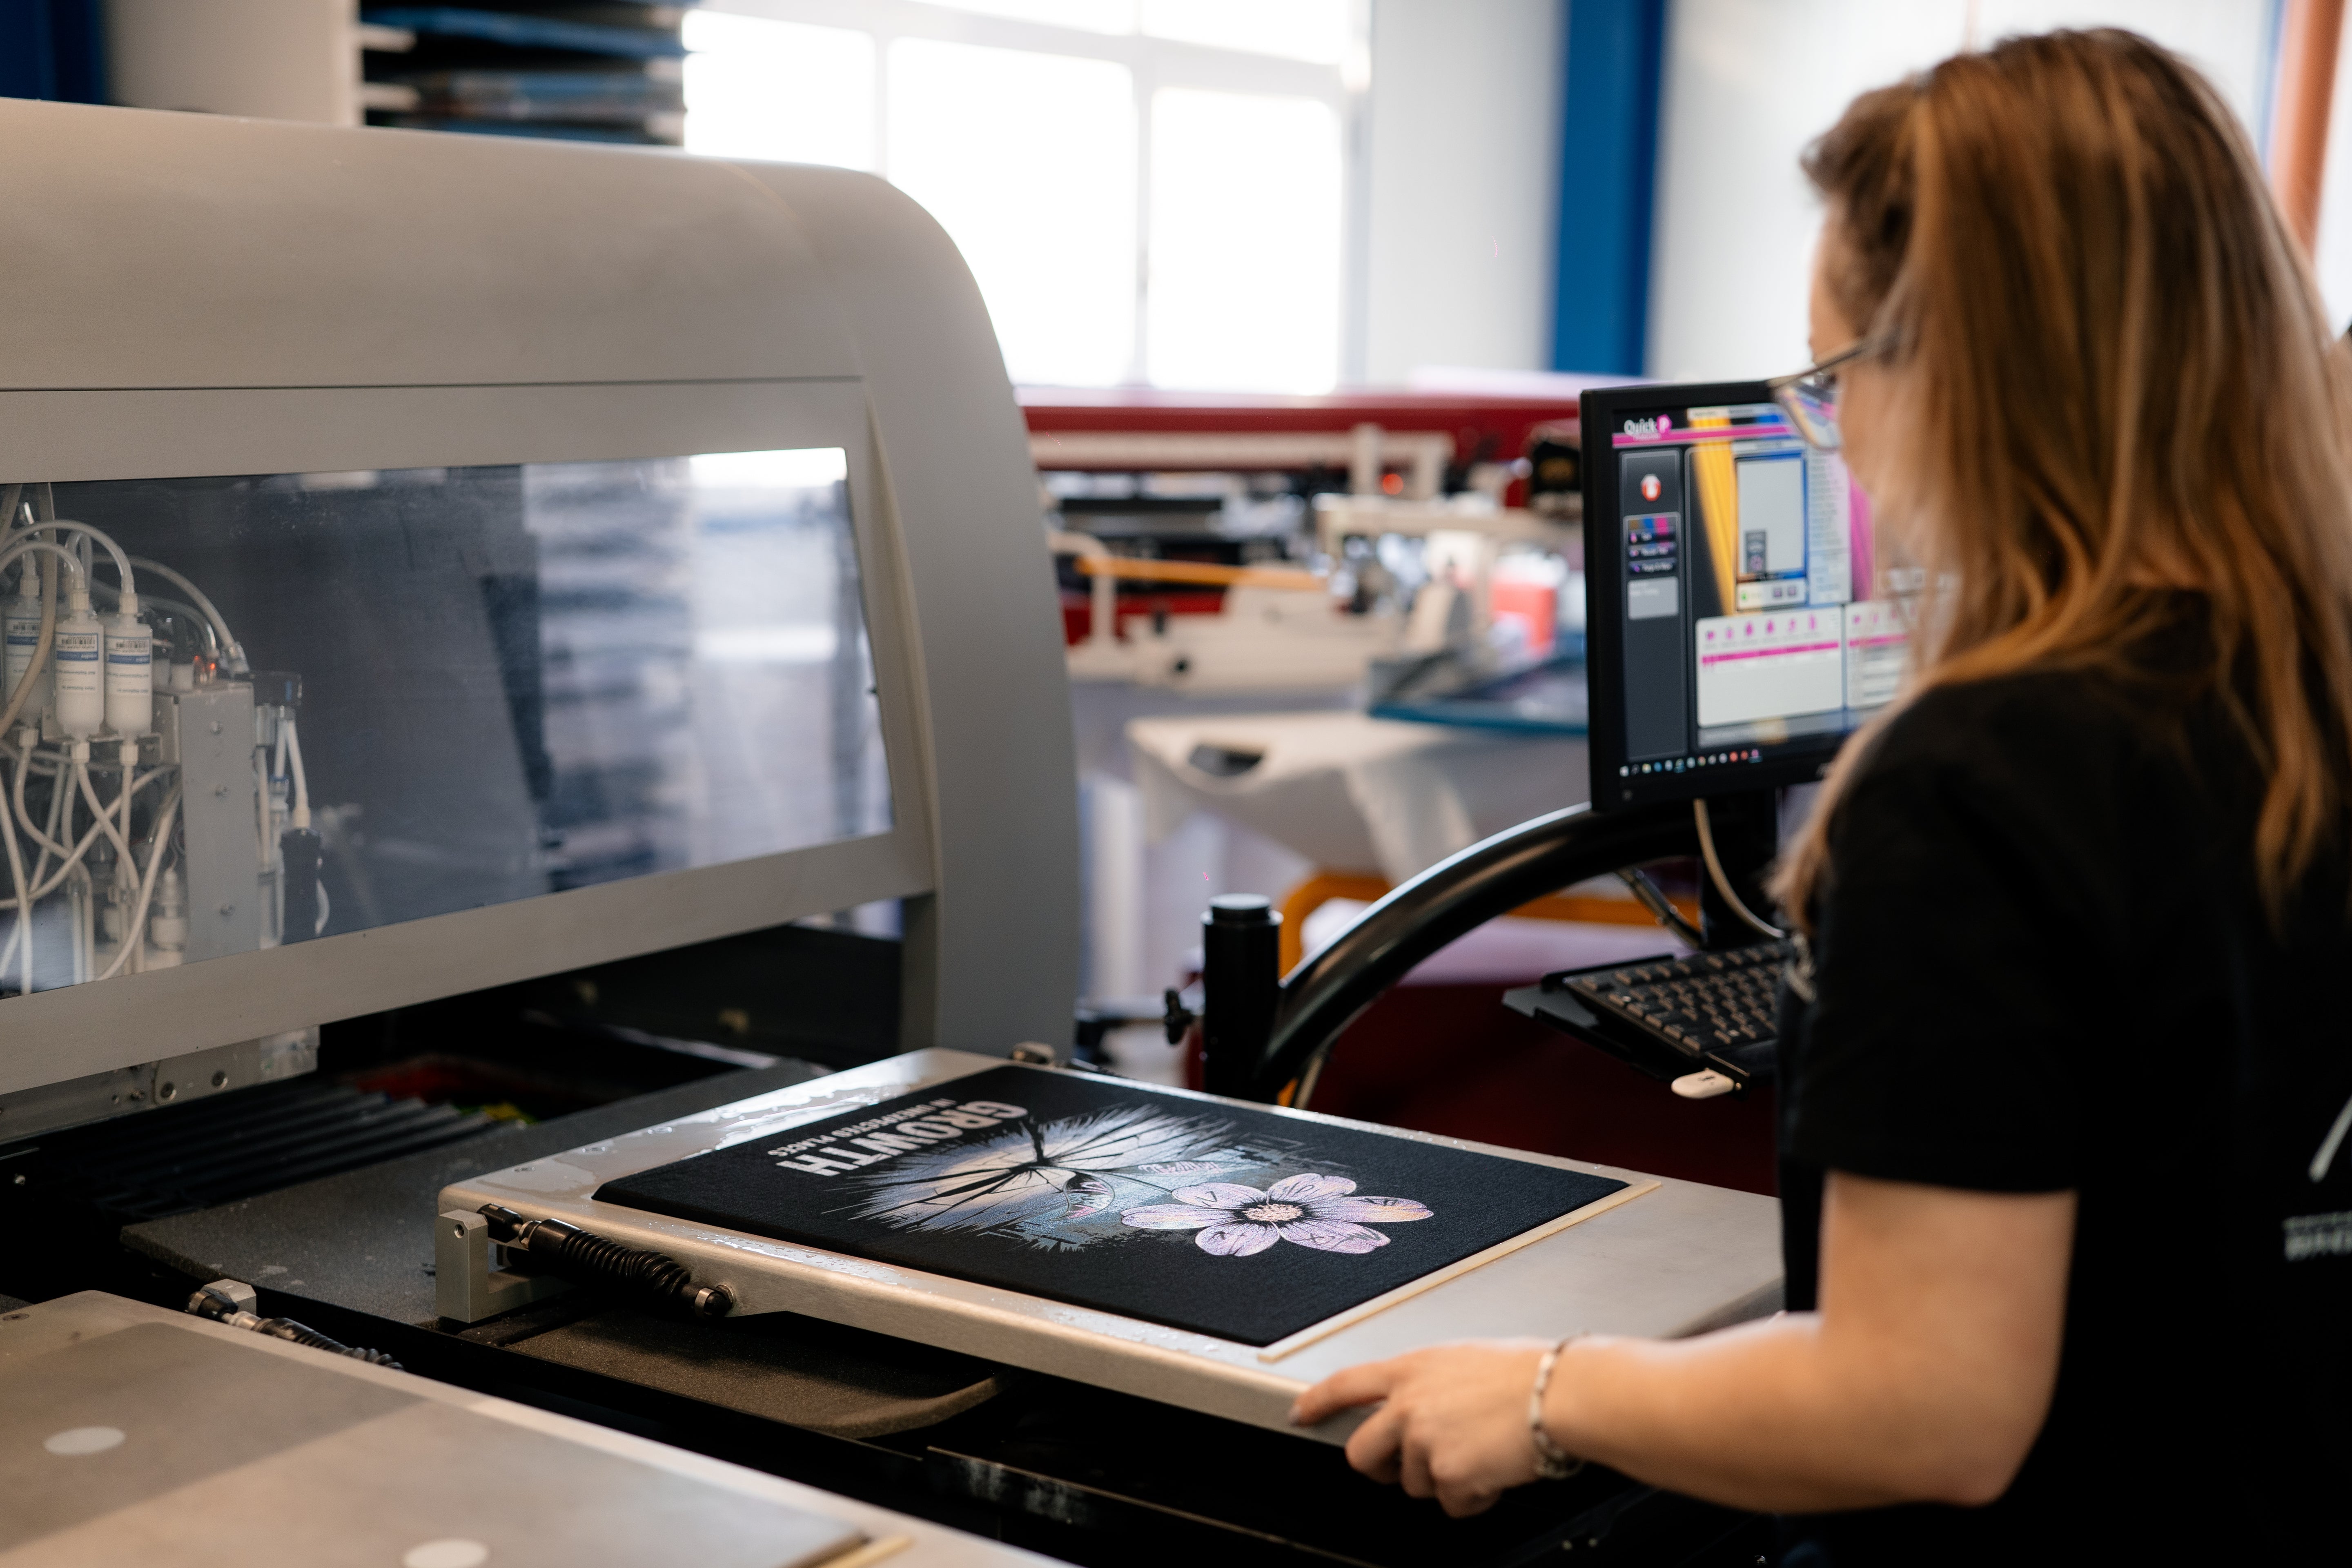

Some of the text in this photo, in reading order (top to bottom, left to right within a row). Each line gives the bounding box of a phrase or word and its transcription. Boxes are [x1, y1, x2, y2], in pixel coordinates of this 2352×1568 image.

[1624, 418, 1657, 435] Quick
[768, 1098, 957, 1157] IN UNEXPECTED PLACES
[776, 1100, 1028, 1177] GROWTH
